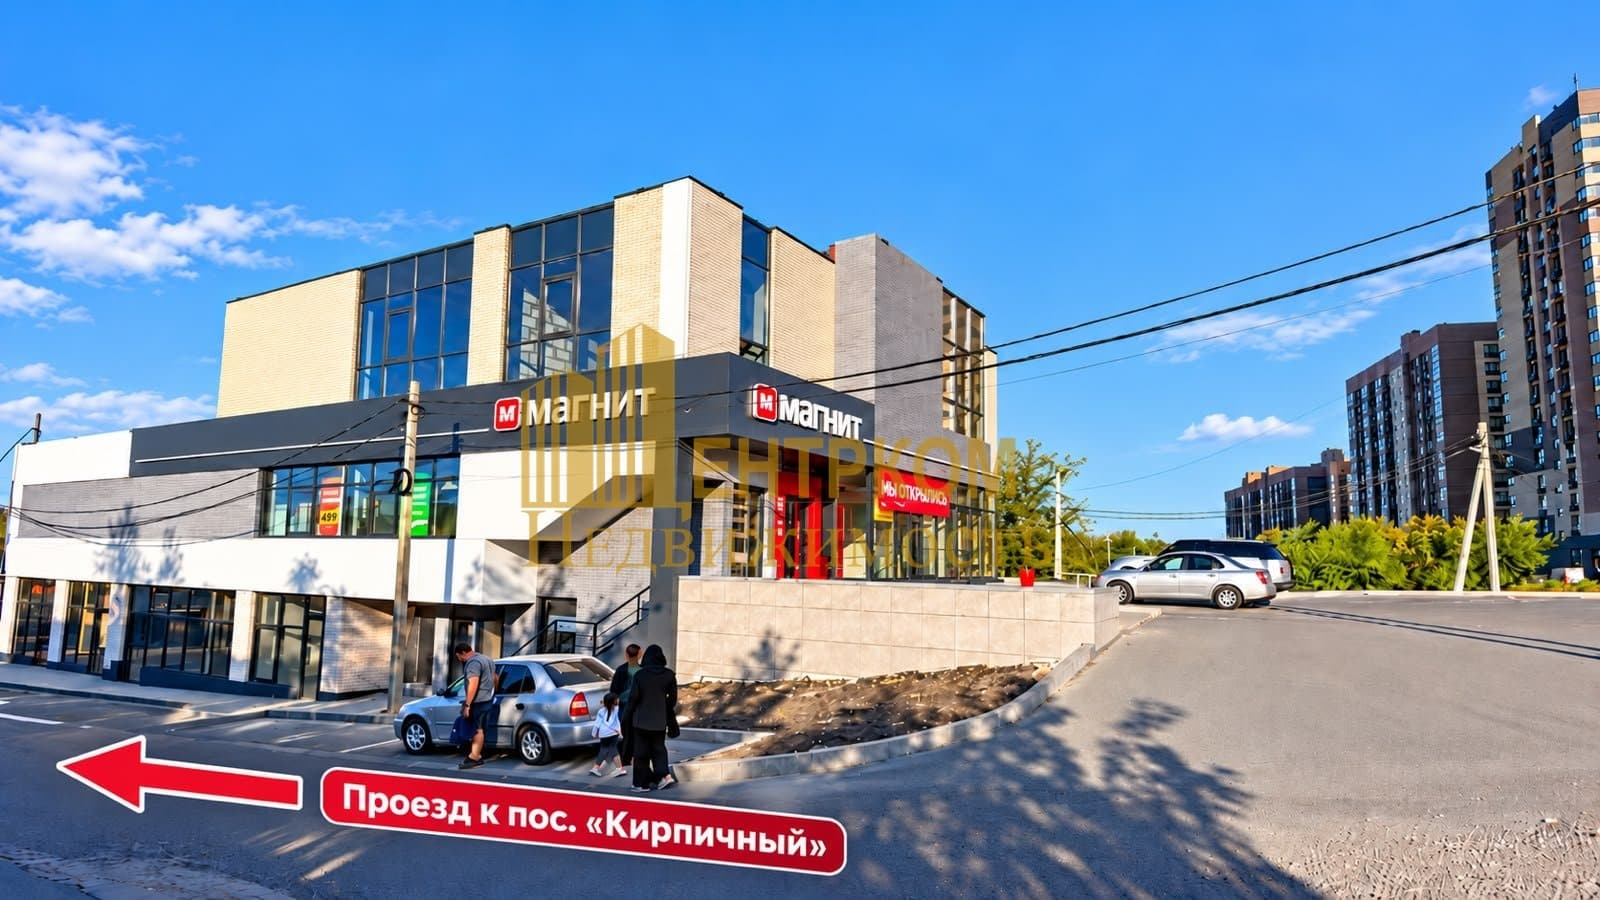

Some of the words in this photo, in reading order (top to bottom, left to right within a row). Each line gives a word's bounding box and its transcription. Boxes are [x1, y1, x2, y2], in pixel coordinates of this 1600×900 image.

[881, 479, 897, 498] МЫ
[898, 483, 948, 506] ОТКРЫЛИСЬ
[320, 512, 338, 522] 499
